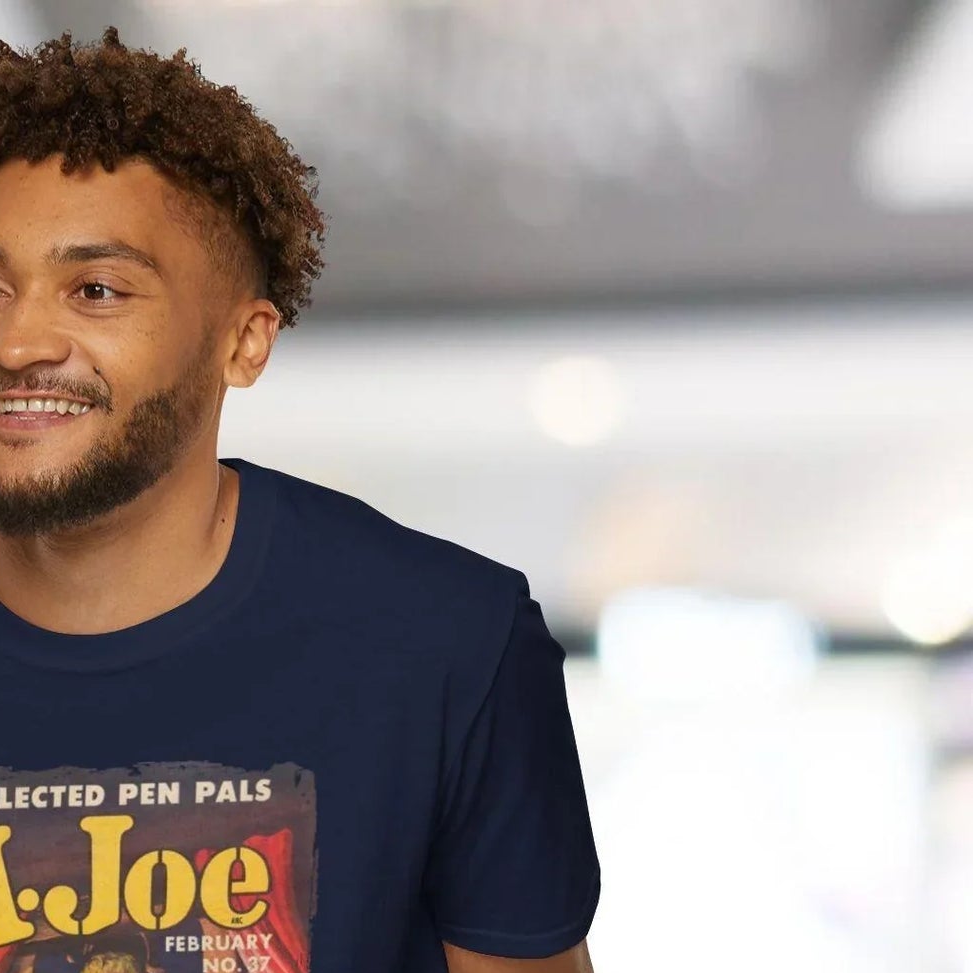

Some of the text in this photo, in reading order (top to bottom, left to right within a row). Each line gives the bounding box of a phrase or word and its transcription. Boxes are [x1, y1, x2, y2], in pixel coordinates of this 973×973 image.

[118, 782, 180, 806] PEN
[195, 778, 272, 804] PALS
[165, 933, 273, 952] FEBRUARY
[202, 956, 270, 973] NO. 37
